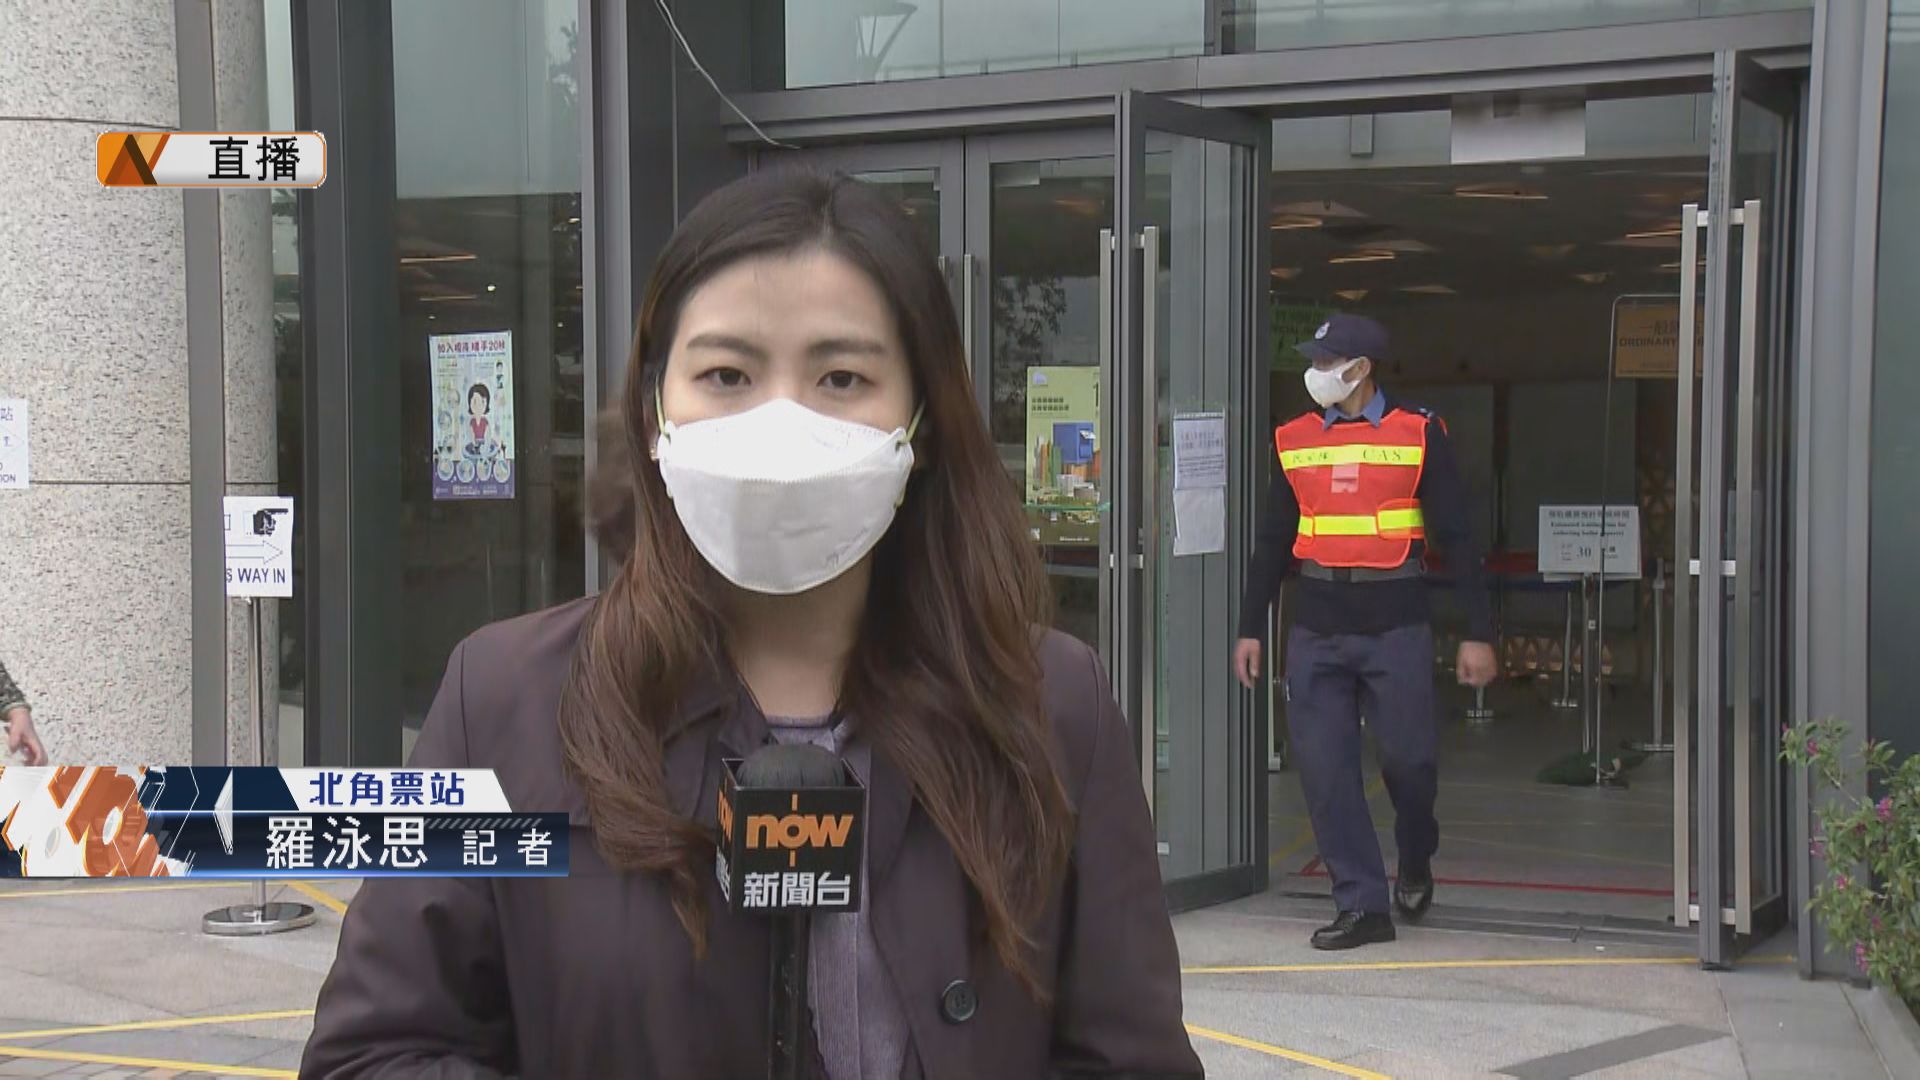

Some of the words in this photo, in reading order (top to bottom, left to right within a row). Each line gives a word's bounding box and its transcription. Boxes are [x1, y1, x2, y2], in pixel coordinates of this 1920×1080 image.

[1362, 449, 1402, 461] CAS
[238, 568, 269, 583] WAY
[273, 568, 286, 583] IN
[746, 814, 854, 849] now
[743, 872, 851, 908] 新聞台
